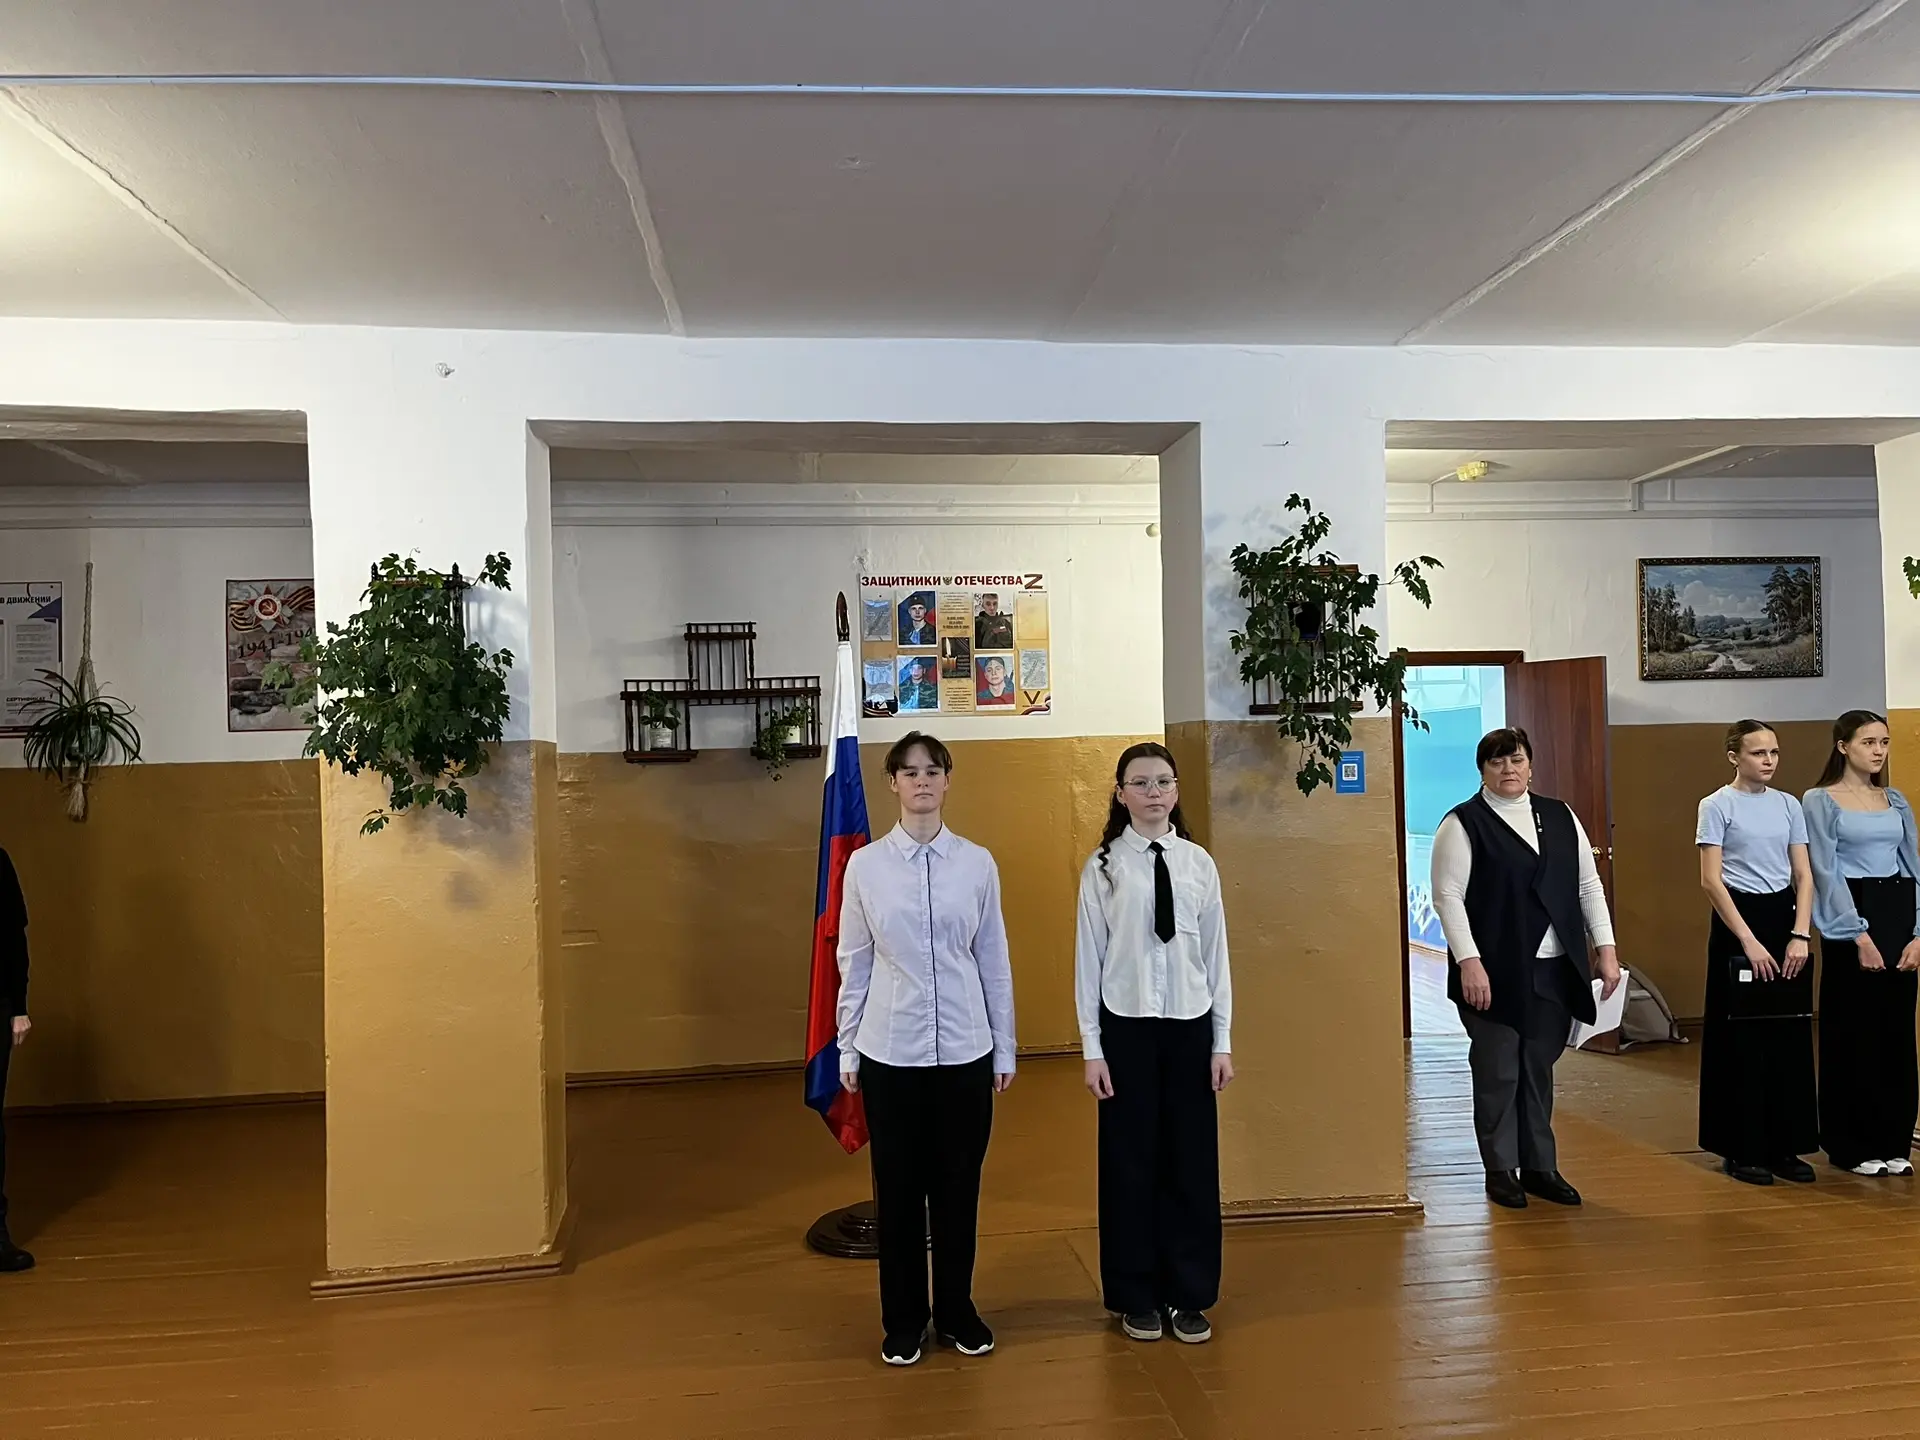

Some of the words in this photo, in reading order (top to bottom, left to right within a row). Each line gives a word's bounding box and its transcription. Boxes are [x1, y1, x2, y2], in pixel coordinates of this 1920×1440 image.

[861, 576, 941, 588] ЗАЩИТНИКИ
[954, 575, 1023, 586] ОТЕЧЕСТВА
[1024, 573, 1043, 590] Z
[6, 596, 51, 605] ДВИЖЕНИИ
[237, 627, 313, 659] 1941-194
[1023, 690, 1041, 704] V
